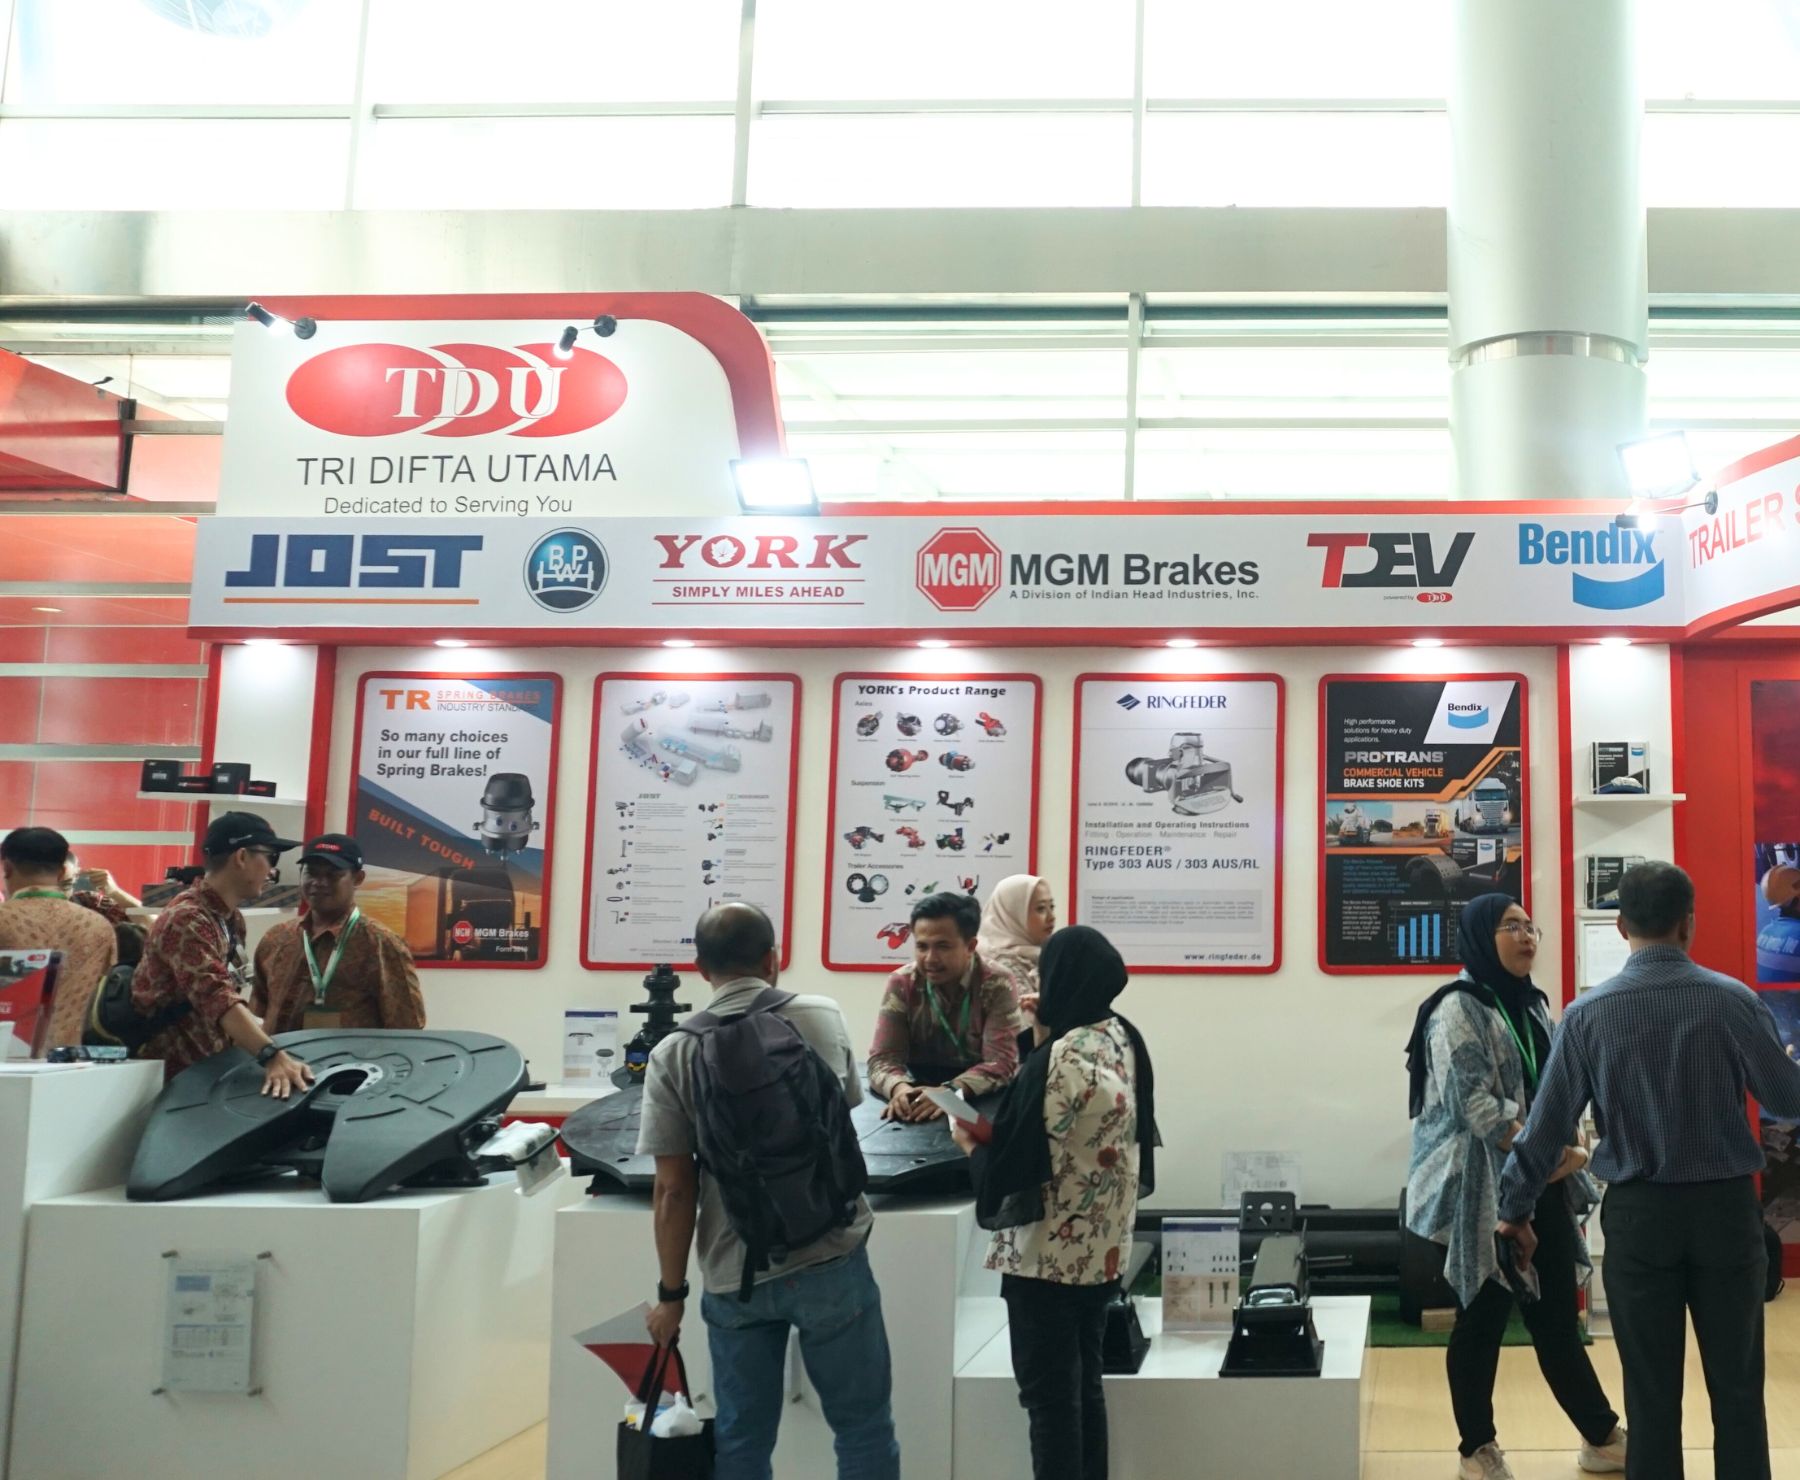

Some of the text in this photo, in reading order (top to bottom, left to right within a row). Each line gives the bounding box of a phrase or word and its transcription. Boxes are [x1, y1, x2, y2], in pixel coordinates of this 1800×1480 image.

[385, 366, 568, 419] TDU
[297, 453, 617, 486] TRI DIFTA UTAMA
[325, 495, 573, 516] Dedicated to Serving You
[1689, 492, 1787, 569] TRAILER
[1518, 523, 1657, 565] Bendix
[654, 535, 868, 569] YORK
[224, 534, 483, 588] JOST
[923, 553, 994, 586] MGM
[1010, 553, 1260, 586] MGM Brakes
[672, 586, 845, 598] SIMPLY MILES AHEAD
[1009, 590, 1260, 601] A Division of Indian Head Industries, Inc.
[437, 690, 484, 700] SPRING
[858, 685, 1007, 698] YORK's Product Range
[380, 689, 431, 710] TR
[1147, 695, 1227, 709] RINGFEDER
[437, 703, 487, 712] INDUSTRY
[1448, 703, 1482, 711] Bendix
[1344, 718, 1395, 726] High performance
[381, 730, 508, 744] So many choices
[1380, 727, 1398, 735] heavy
[1399, 727, 1412, 735] duty
[378, 746, 501, 759] in our full line of
[377, 764, 487, 778] Spring Brakes!
[1344, 768, 1444, 777] COMMERCIAL VEHICLE
[1344, 779, 1425, 788] BRAKE SHOE KITS
[1155, 821, 1196, 829] Operating
[368, 808, 477, 870] BUILT TOUGH
[1085, 858, 1260, 871] Type 303 AUS / 303 AUS/RL
[474, 928, 529, 938] MGM Brakes
